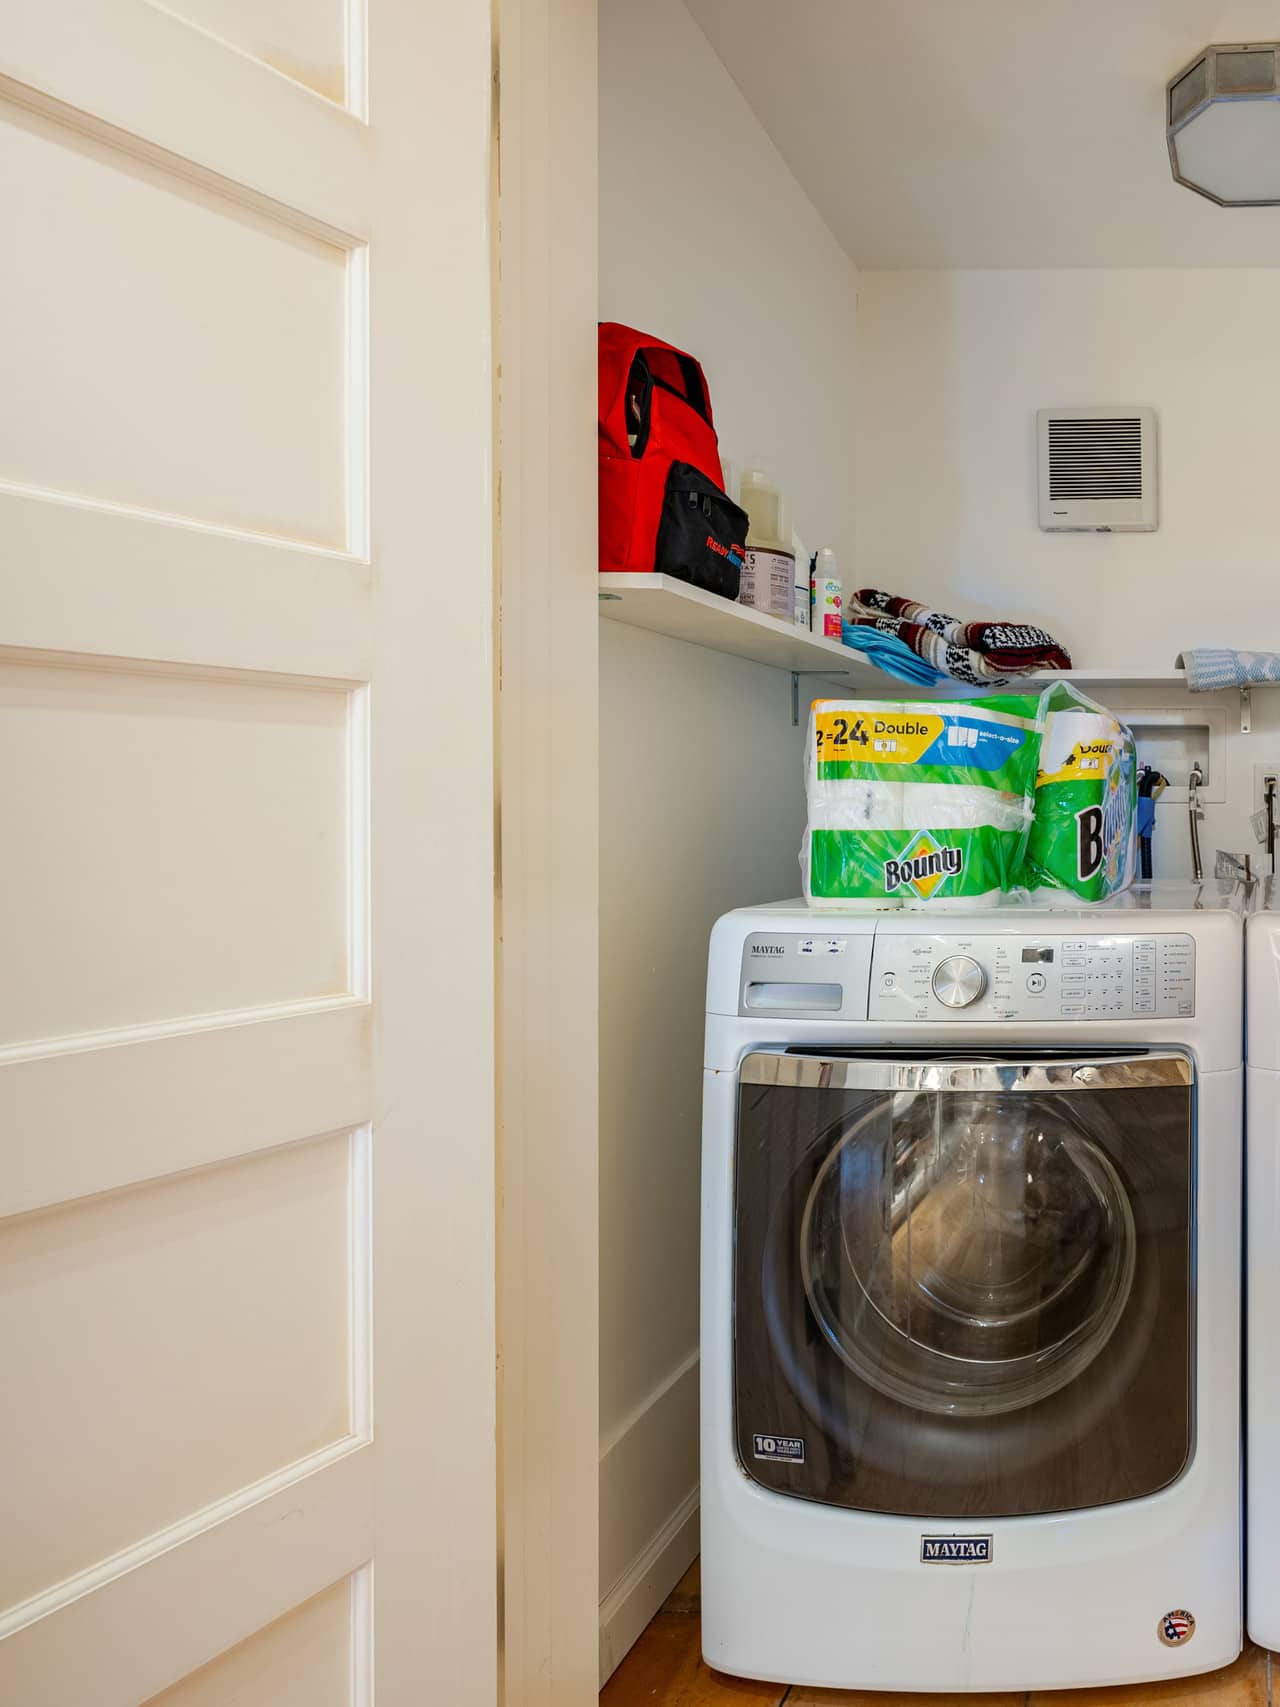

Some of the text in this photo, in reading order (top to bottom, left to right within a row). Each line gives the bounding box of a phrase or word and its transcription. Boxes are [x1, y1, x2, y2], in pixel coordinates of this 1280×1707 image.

[874, 720, 929, 736] Double
[885, 847, 962, 892] Bounty
[751, 945, 785, 954] MAYTAG
[756, 1437, 801, 1452] 10 YEAR
[925, 1542, 987, 1557] MAYTAG
